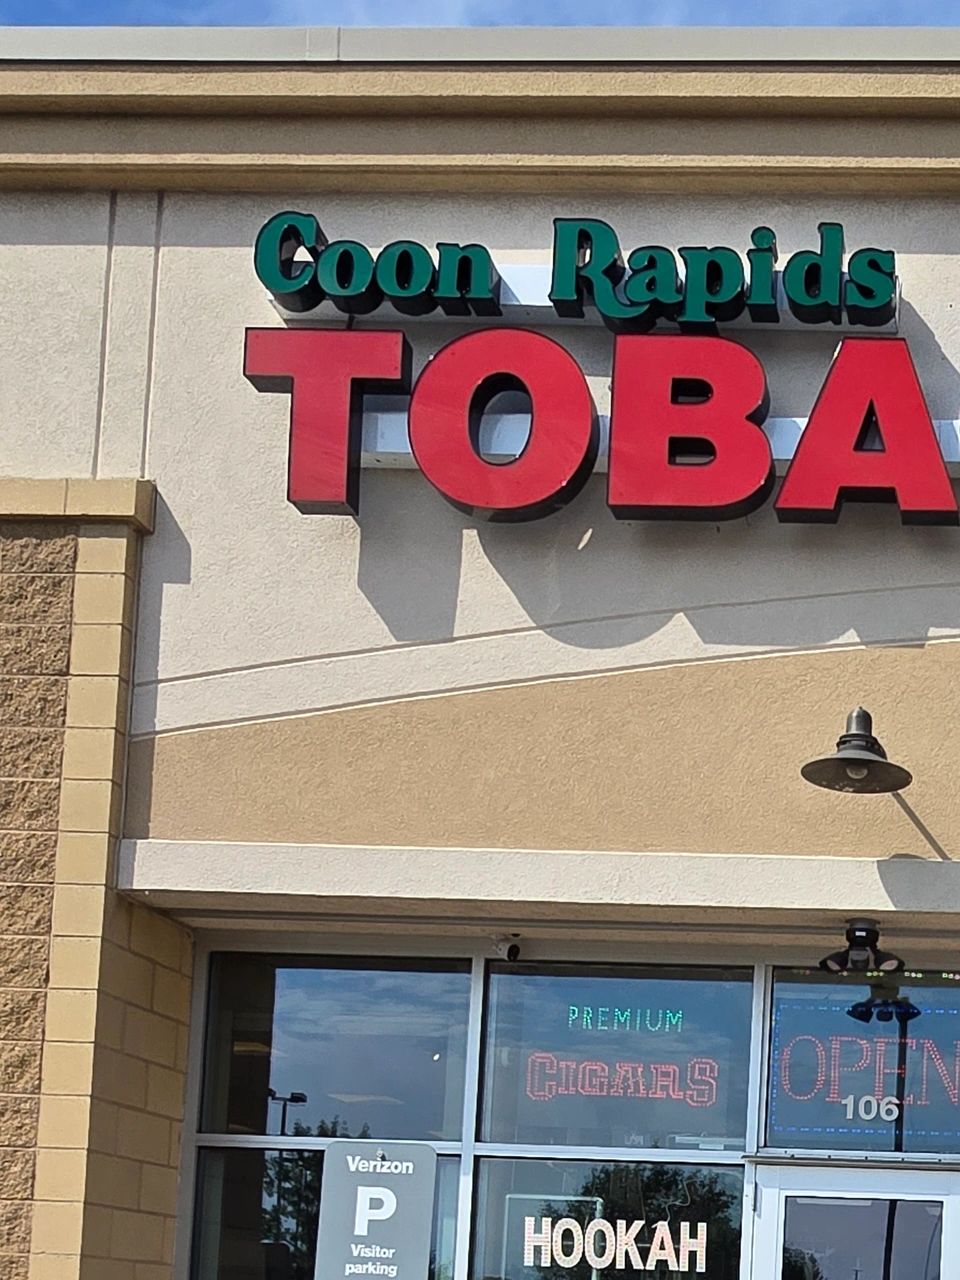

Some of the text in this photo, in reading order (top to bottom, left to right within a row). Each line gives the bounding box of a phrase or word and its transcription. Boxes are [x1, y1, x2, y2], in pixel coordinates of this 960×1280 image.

[254, 211, 897, 322] Coon Rapids
[568, 1006, 683, 1032] PREMIUM
[525, 1052, 719, 1107] CIGARS
[841, 1095, 900, 1122] 106
[346, 1155, 414, 1175] Verizon
[353, 1186, 397, 1236] P
[350, 1243, 396, 1259] Visitor
[523, 1216, 708, 1273] HOOKAH
[344, 1262, 398, 1278] parking
